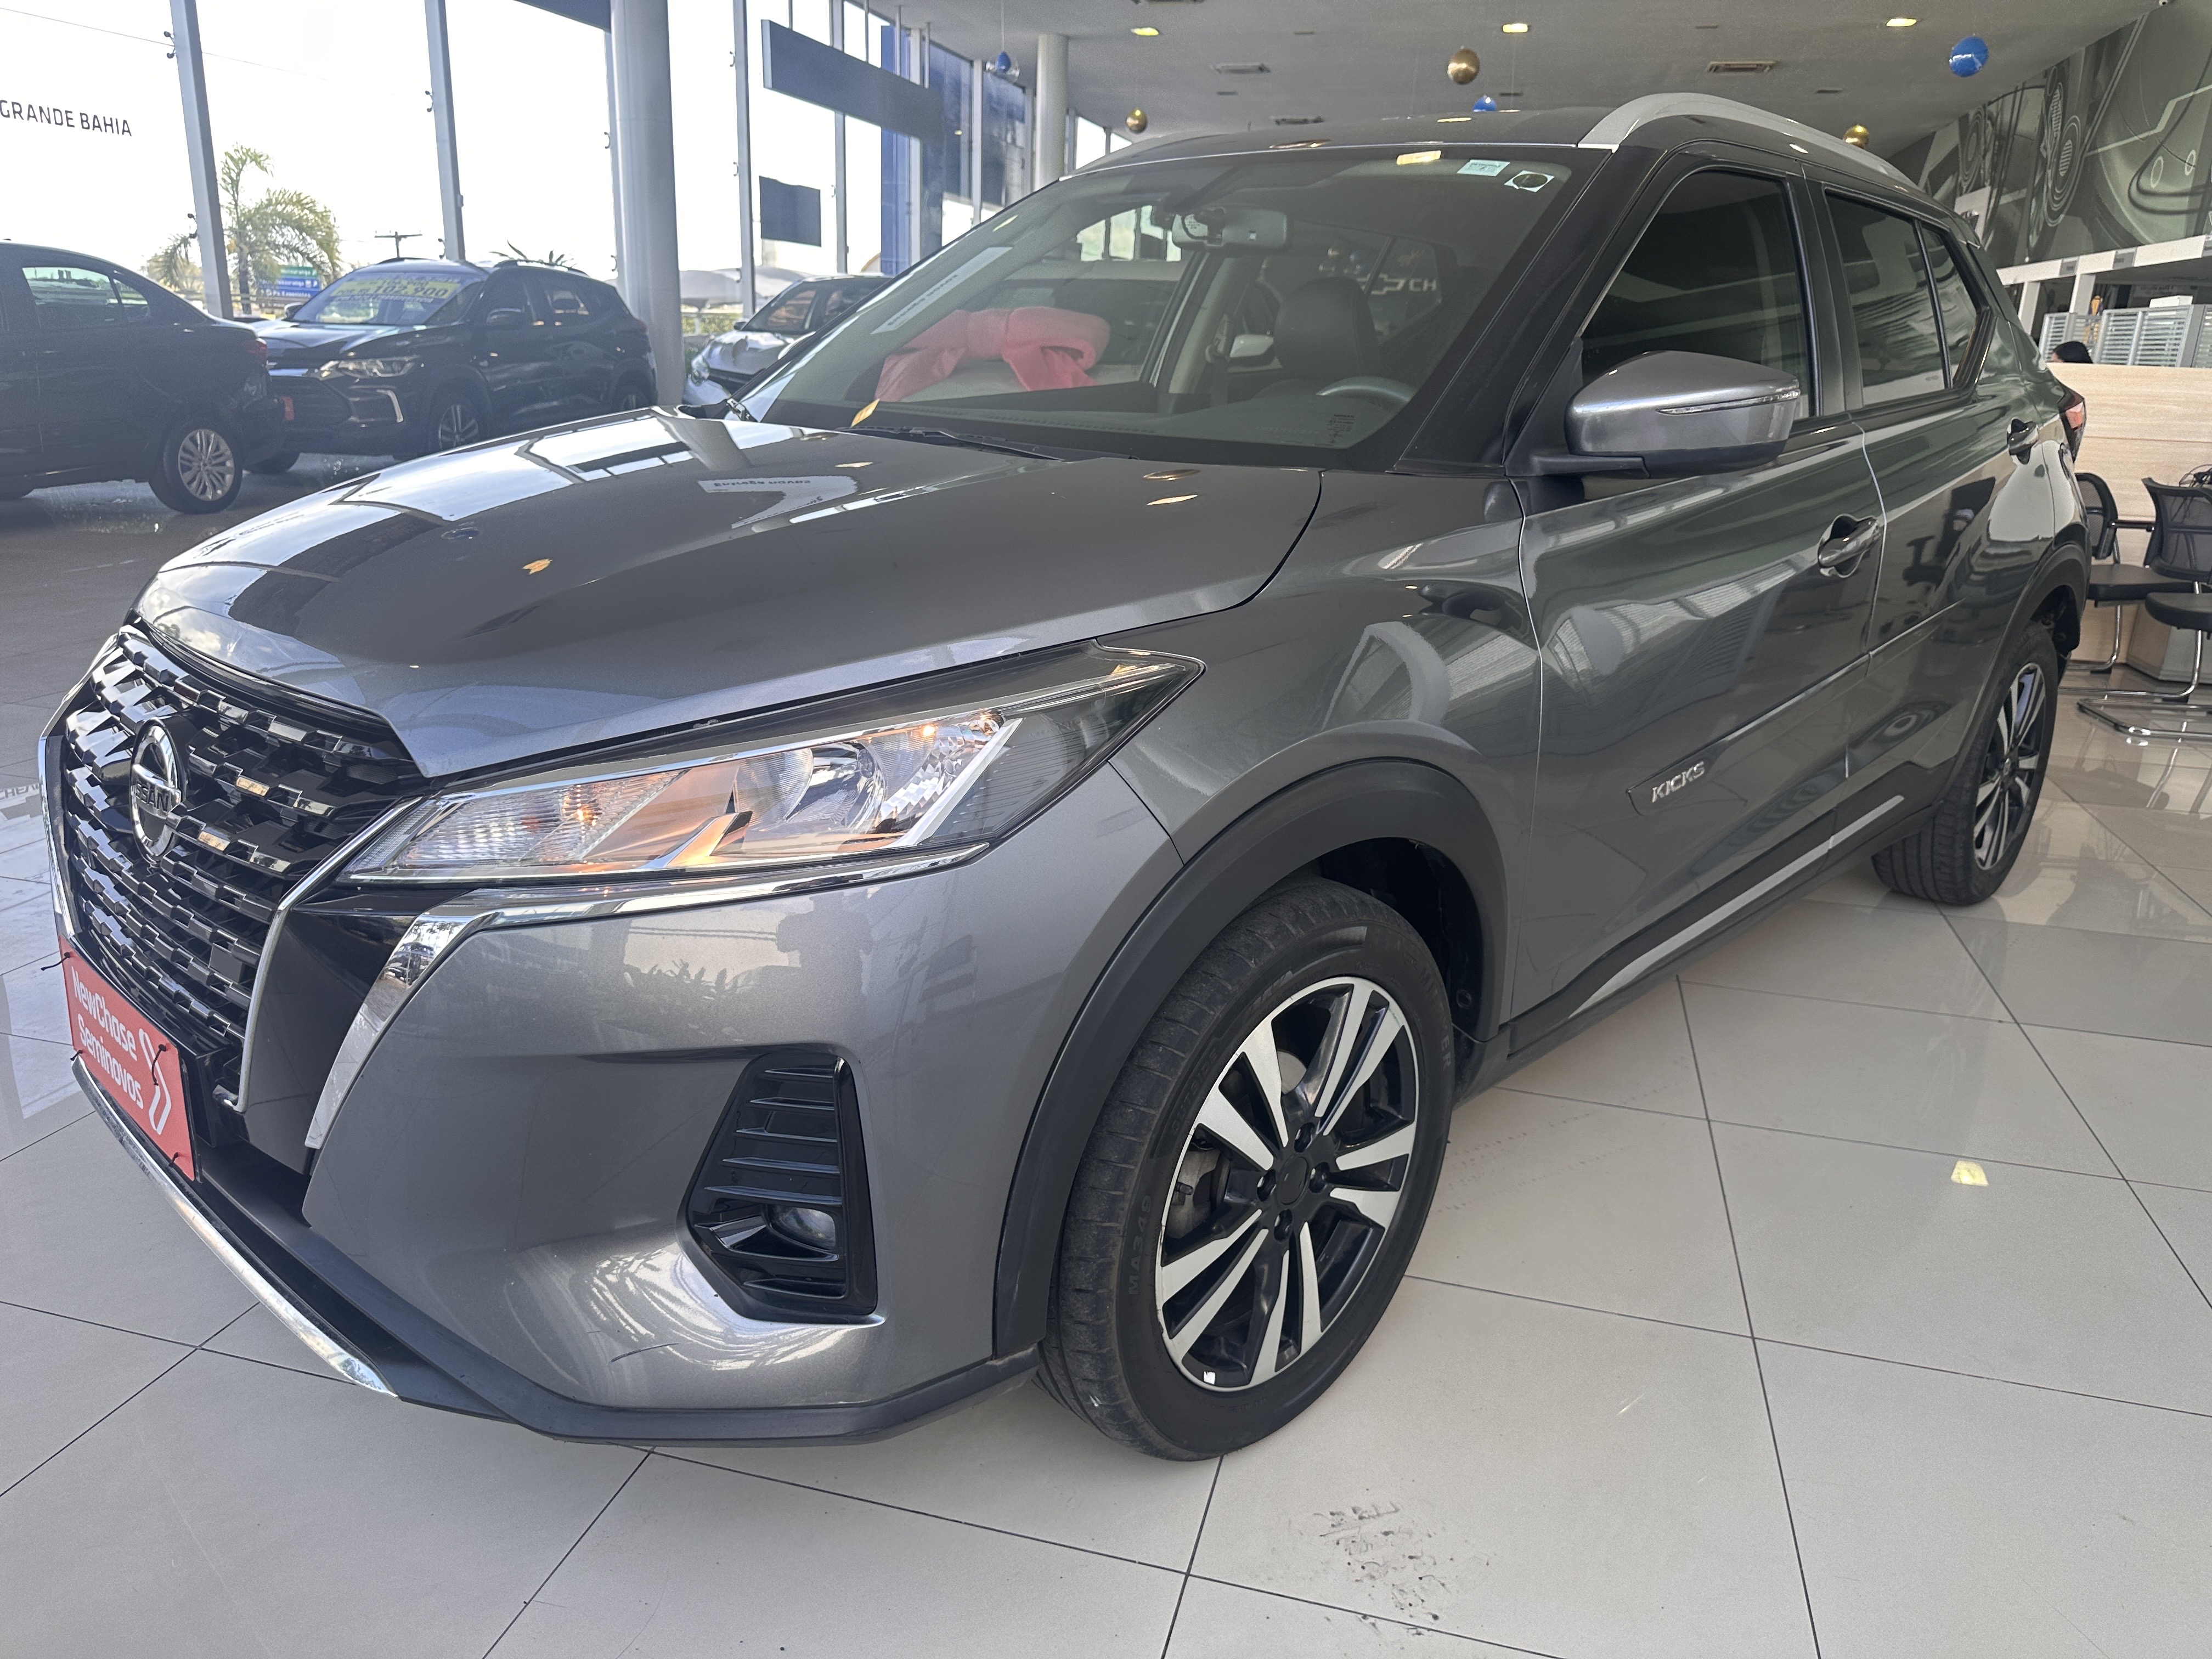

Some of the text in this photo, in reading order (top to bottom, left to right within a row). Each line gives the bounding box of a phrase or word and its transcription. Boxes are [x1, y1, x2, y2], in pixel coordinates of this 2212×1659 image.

[0, 99, 132, 137] GRANDE BAHIA
[1650, 761, 1705, 803] KICKS
[71, 966, 138, 1061] NewChase
[78, 1013, 144, 1109] Seminovos
[1128, 1194, 1152, 1295] MA349
